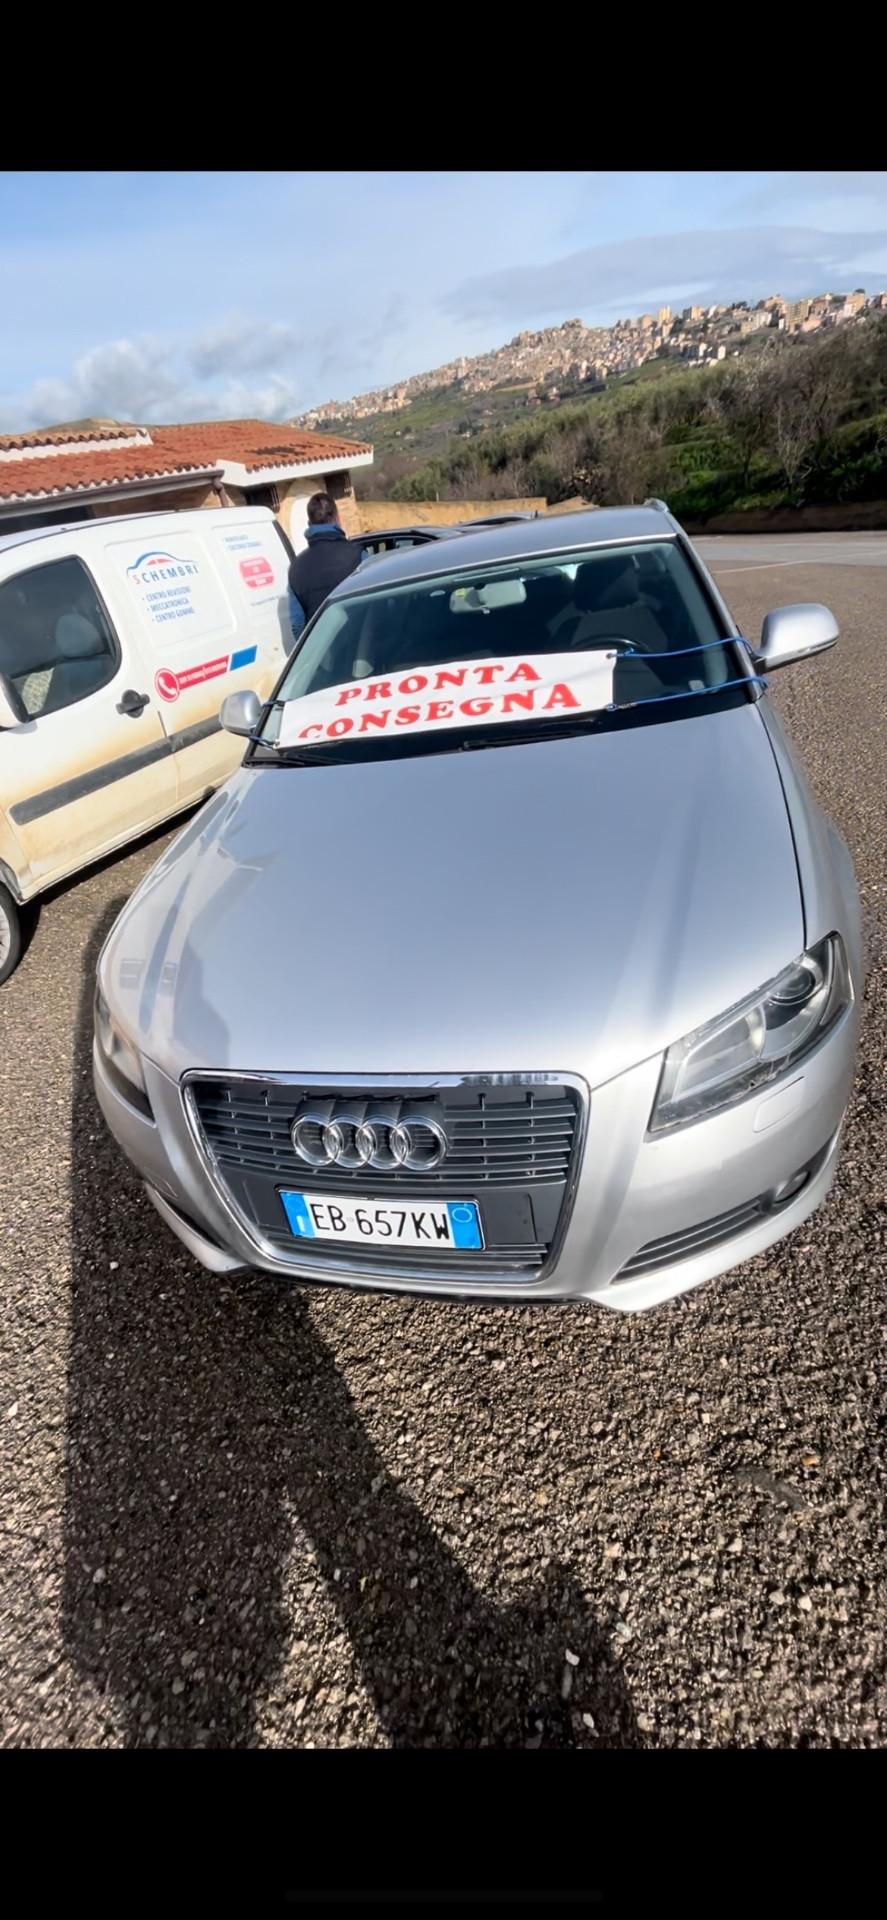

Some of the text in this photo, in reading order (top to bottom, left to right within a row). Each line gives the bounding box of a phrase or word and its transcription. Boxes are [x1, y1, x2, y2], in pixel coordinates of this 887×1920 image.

[132, 565, 198, 584] SCHEMBRI
[146, 592, 167, 602] CENTRO
[155, 611, 176, 623] CENTRO
[335, 663, 542, 706] PRONTA
[298, 683, 581, 738] CONSEGNA
[310, 1204, 346, 1232] EB
[355, 1209, 450, 1240] 657KW
